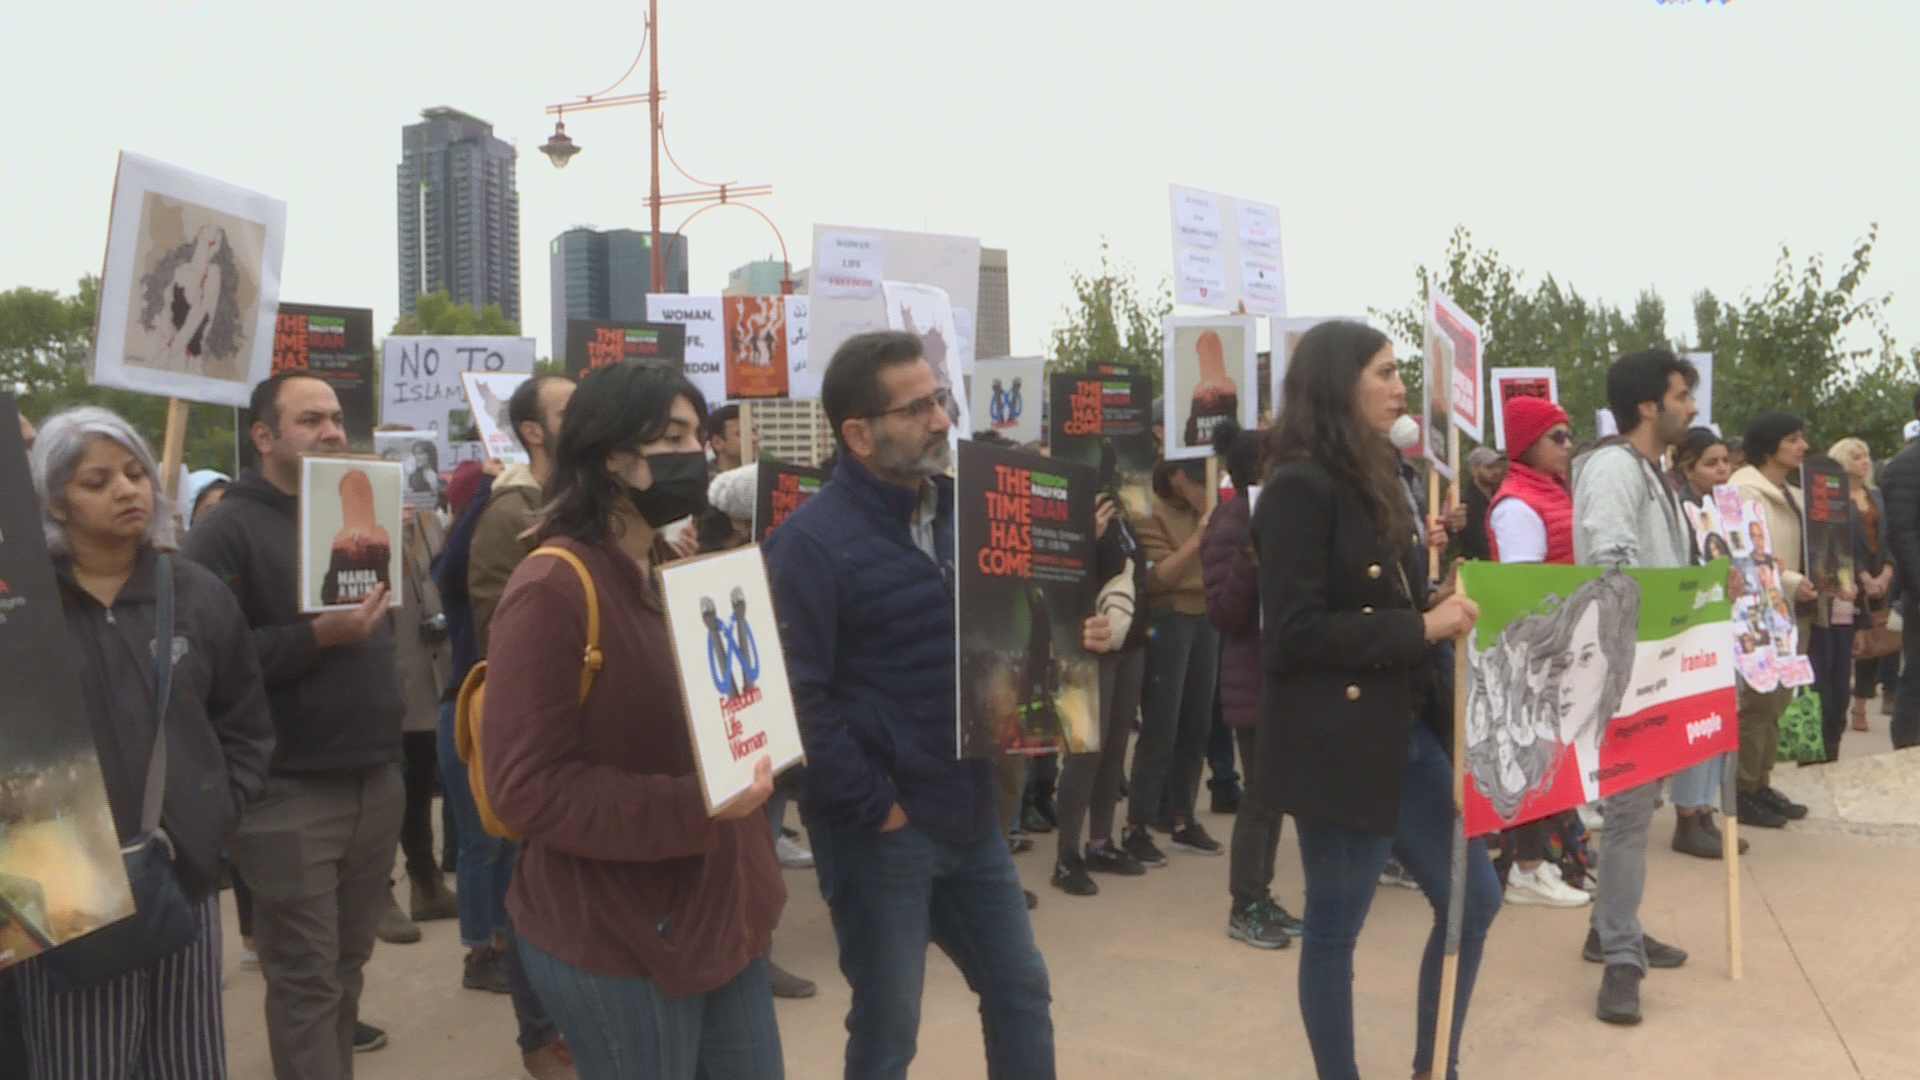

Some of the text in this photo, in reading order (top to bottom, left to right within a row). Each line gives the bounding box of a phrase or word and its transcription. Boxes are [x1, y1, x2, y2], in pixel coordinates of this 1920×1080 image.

[662, 309, 715, 321] WOMAN,
[400, 342, 440, 379] NO
[456, 347, 505, 372] TO
[393, 382, 467, 403] ISLAM
[995, 464, 1031, 496] THE
[985, 489, 1031, 523] TIME
[990, 520, 1032, 551] HAS
[978, 546, 1032, 577] COME
[1681, 648, 1718, 673] Iranian
[719, 687, 763, 716] Freedom
[722, 714, 744, 740] Life
[1686, 711, 1722, 745] people
[728, 730, 768, 763] Woman
